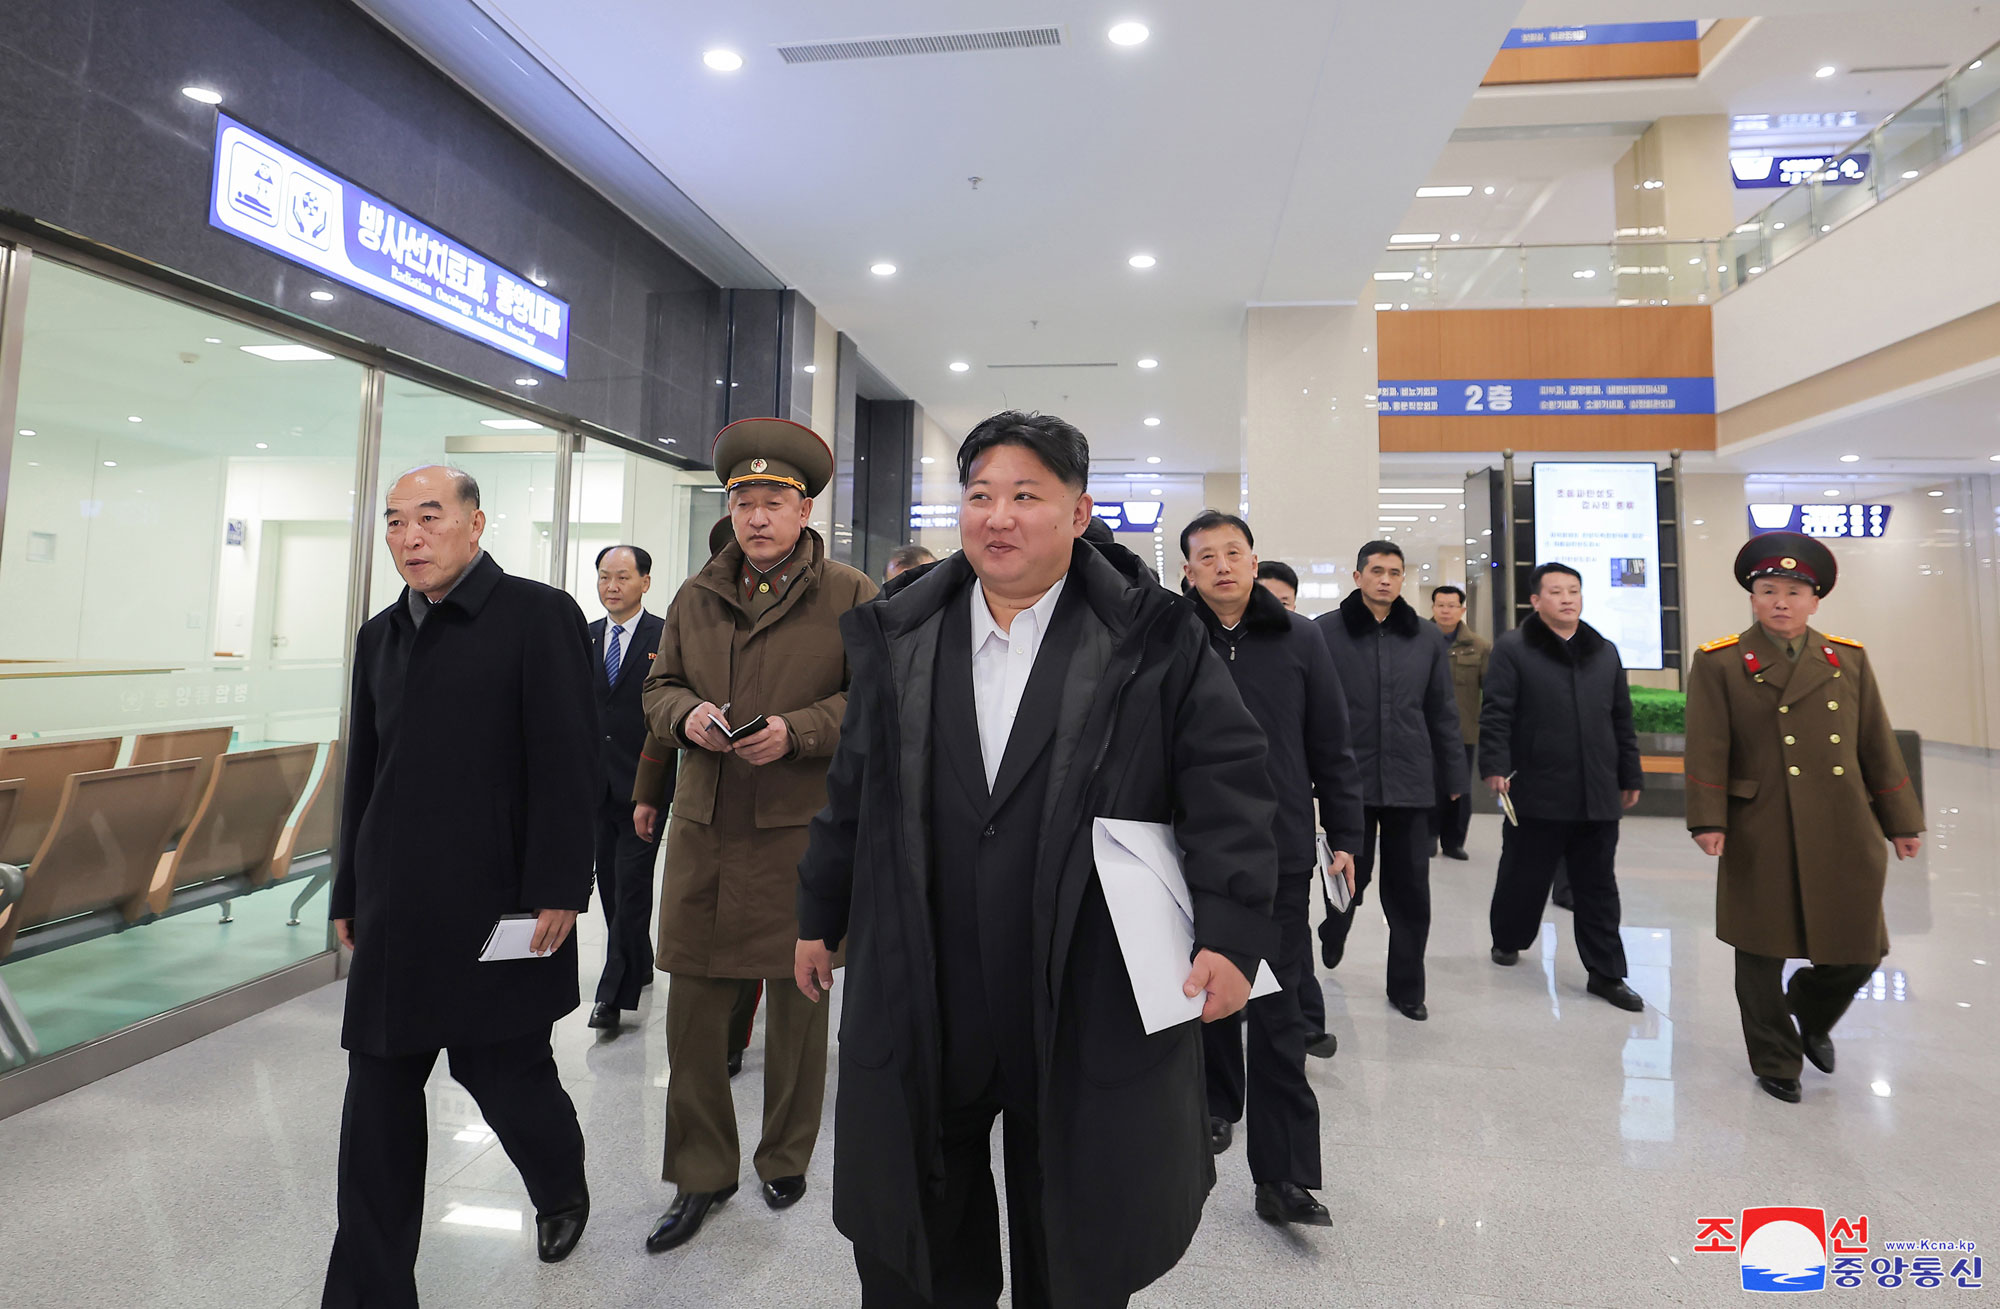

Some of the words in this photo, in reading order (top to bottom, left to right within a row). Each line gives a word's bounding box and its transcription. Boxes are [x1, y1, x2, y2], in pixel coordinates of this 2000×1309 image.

[358, 200, 489, 306] 방사선치료과,
[495, 274, 561, 340] 종양내과
[391, 265, 432, 296] Radiation
[476, 305, 504, 329] Medical
[1464, 384, 1513, 411] 2층
